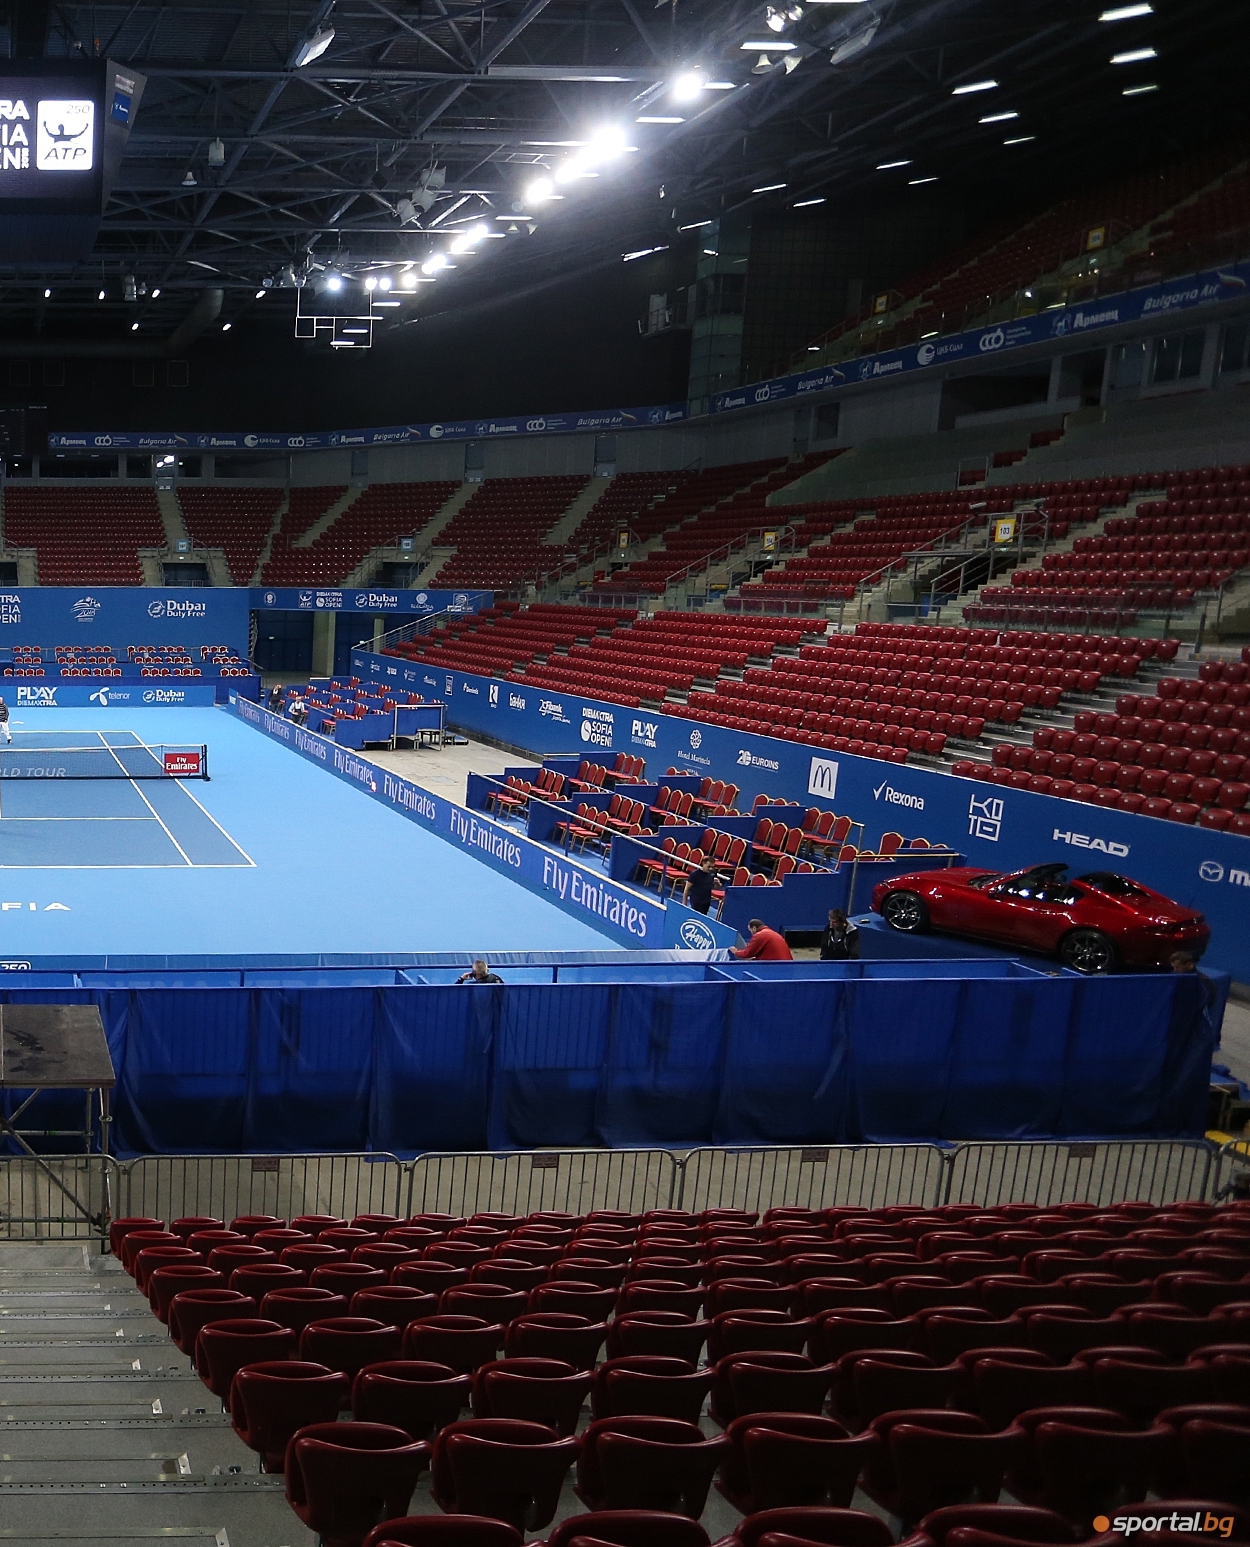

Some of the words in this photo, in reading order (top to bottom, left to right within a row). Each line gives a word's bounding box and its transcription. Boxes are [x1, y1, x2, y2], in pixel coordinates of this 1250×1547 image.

[43, 147, 87, 161] ATP
[1143, 288, 1199, 310] Bulgaria
[1200, 283, 1220, 298] Air
[166, 599, 206, 611] Dubai
[368, 594, 398, 602] Dubai
[166, 610, 186, 619] Duty
[17, 686, 57, 700] PLAY
[108, 691, 130, 700] telenor
[156, 689, 184, 698] Dubai
[264, 713, 272, 732] Fly
[271, 716, 290, 740] Emirates
[591, 721, 613, 737] SOFIA
[631, 719, 658, 739] PLAY
[295, 729, 304, 751] Fly
[304, 734, 327, 760] Emirates
[590, 732, 610, 747] OPEN
[166, 762, 198, 771] Emirates
[334, 749, 345, 774] Fly
[345, 754, 373, 786] Emirates
[751, 756, 779, 770] EUROINS
[27, 767, 67, 777] TOUR
[384, 774, 398, 803] Fly
[398, 781, 436, 820] Emirates
[885, 786, 925, 811] Rexona
[451, 808, 469, 843] Fly
[469, 818, 521, 868] Emirates
[1052, 828, 1129, 858] HEAD
[543, 856, 569, 900] Fly
[571, 870, 647, 938] Emirates
[684, 925, 712, 949] Happy
